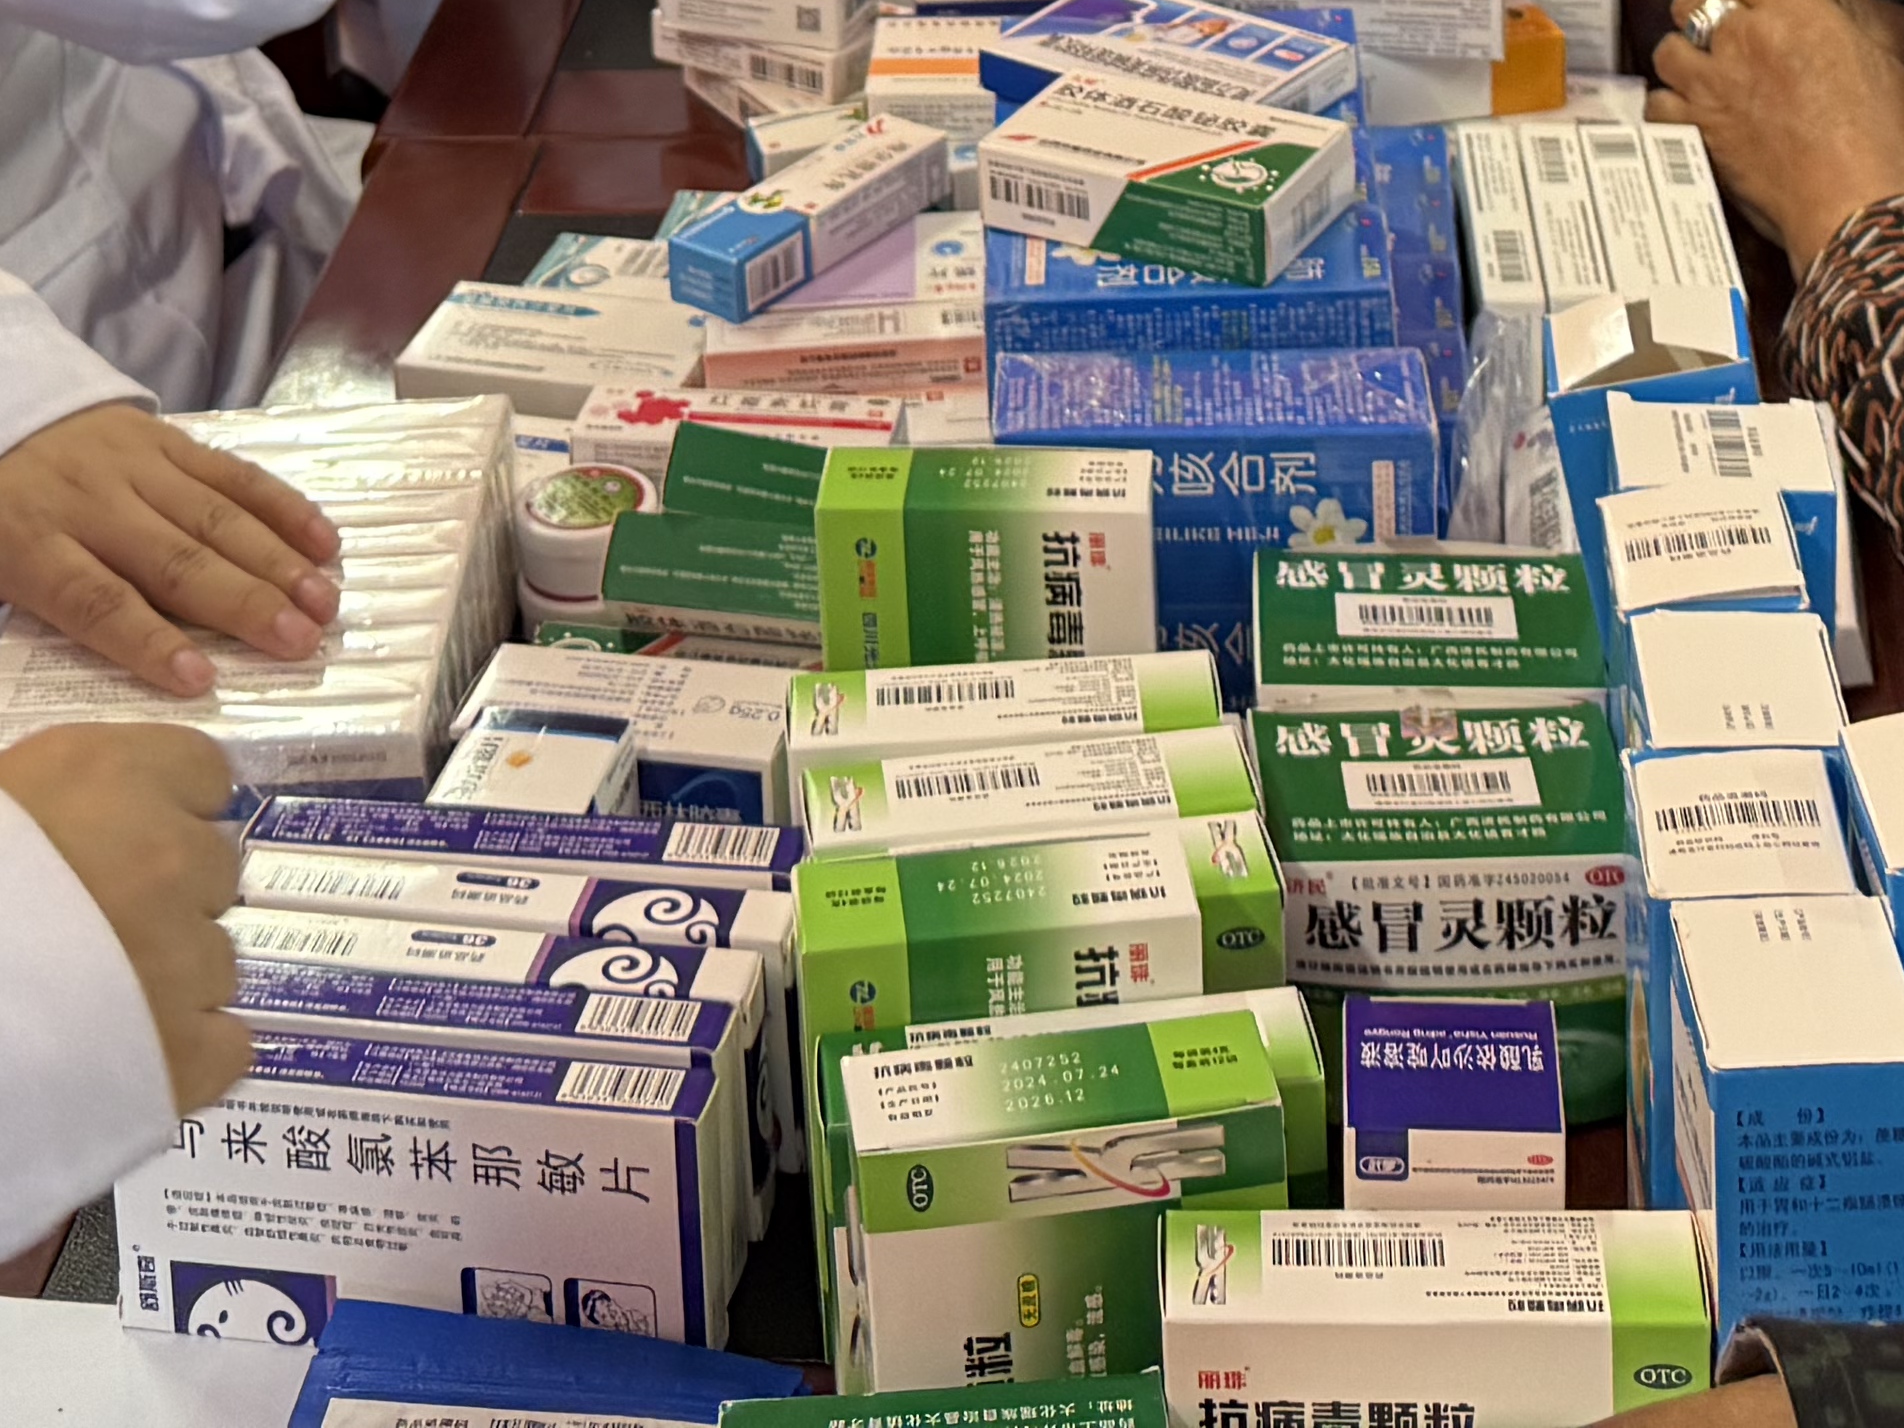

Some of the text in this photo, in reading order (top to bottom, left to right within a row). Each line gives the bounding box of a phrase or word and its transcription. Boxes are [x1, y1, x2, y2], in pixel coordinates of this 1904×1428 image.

[1053, 82, 1276, 138] 胶体酒石酸铋胶囊
[1042, 531, 1085, 658] 抗病毒
[1276, 559, 1571, 595] 感冒灵颗粒
[1221, 931, 1261, 947] OTC
[1306, 892, 1618, 953] 感冒灵颗粒
[999, 1051, 1082, 1074] 2407252
[1361, 1041, 1544, 1072] 乳酸依沙吖啶溶液
[1005, 1087, 1085, 1113] 2026.12
[910, 1166, 929, 1210] OTC
[963, 1332, 1014, 1387] 粒
[1639, 1368, 1688, 1386] OTC
